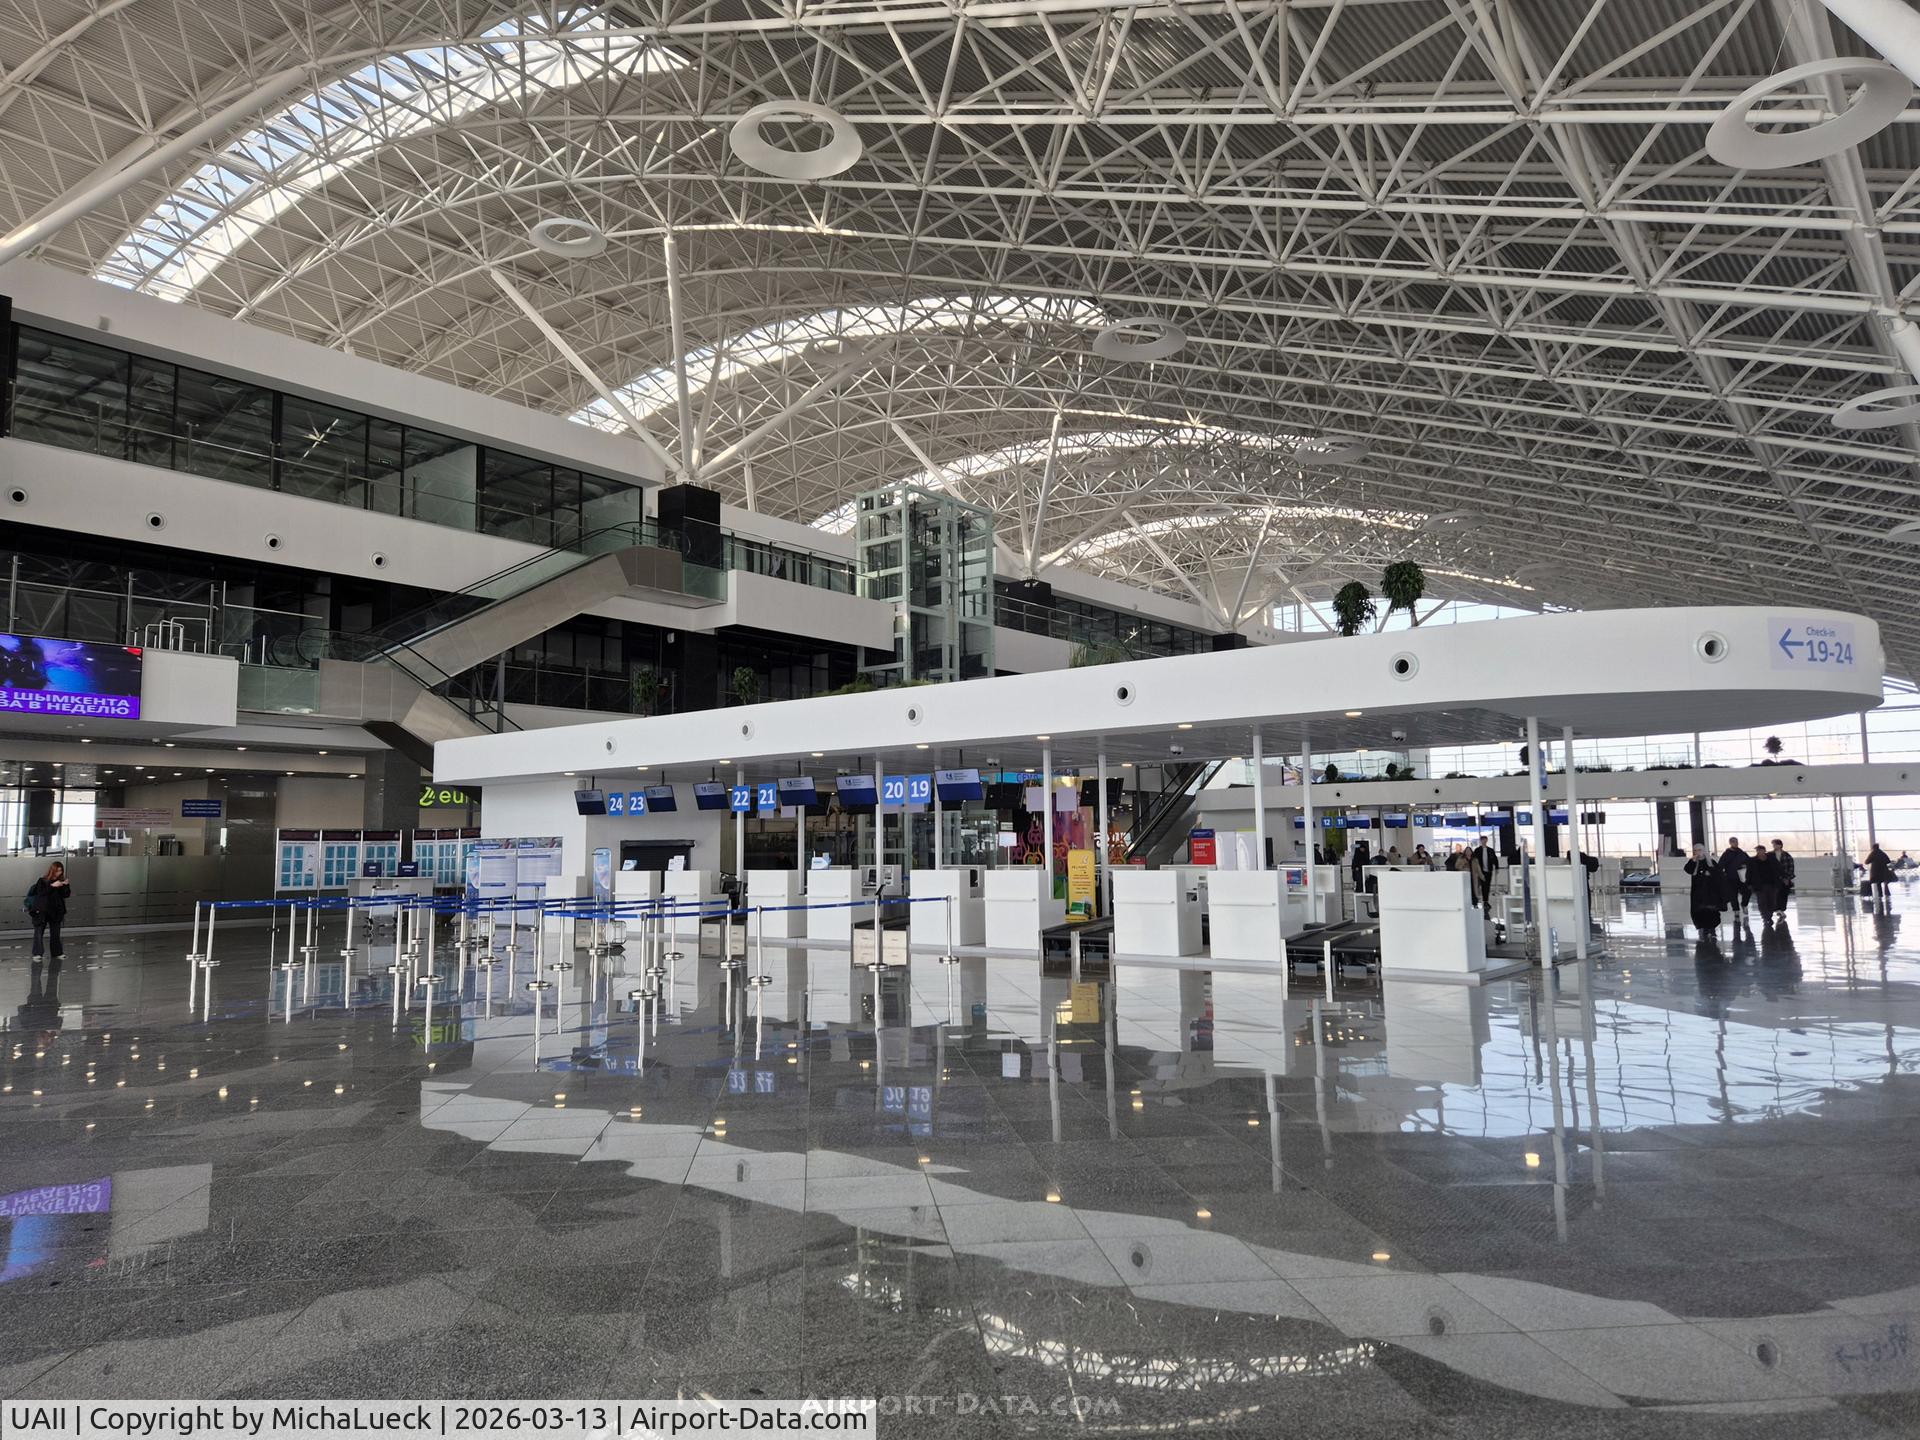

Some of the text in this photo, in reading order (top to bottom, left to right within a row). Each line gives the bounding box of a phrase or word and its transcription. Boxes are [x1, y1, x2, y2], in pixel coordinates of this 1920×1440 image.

[1805, 626, 1836, 638] Check-in
[1806, 640, 1853, 665] 19-24
[13, 691, 130, 707] ШЫМКЕНТА
[29, 701, 41, 710] В
[47, 702, 130, 715] НЕДЕЛЮ
[759, 789, 775, 805] 21
[885, 782, 904, 799] 20
[911, 780, 929, 798] 19
[609, 797, 623, 812] 24
[630, 796, 644, 811] 23
[733, 791, 748, 807] 22
